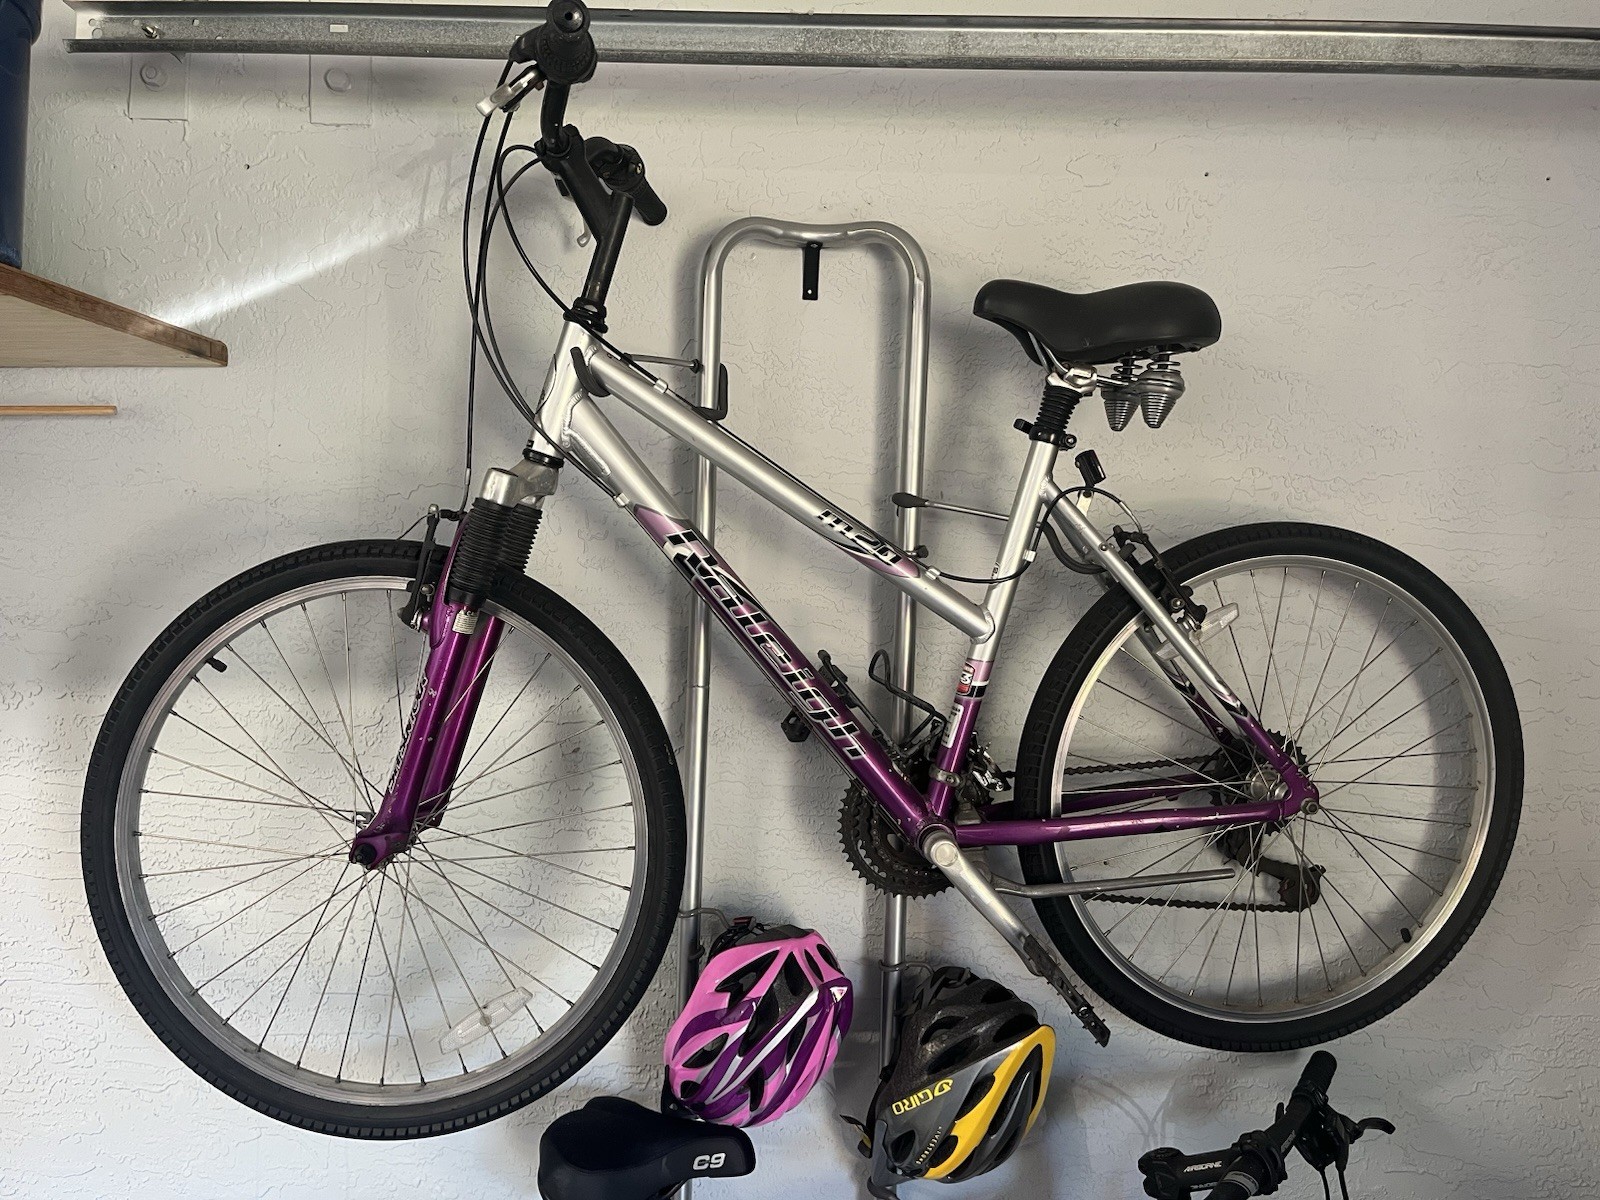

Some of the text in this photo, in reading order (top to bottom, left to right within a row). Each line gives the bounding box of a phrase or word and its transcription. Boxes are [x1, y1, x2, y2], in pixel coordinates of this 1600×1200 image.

[665, 529, 866, 760] Raleigh
[892, 1088, 934, 1116] GIRO
[692, 1152, 726, 1170] C9
[1183, 1160, 1223, 1173] AIRBORNE
